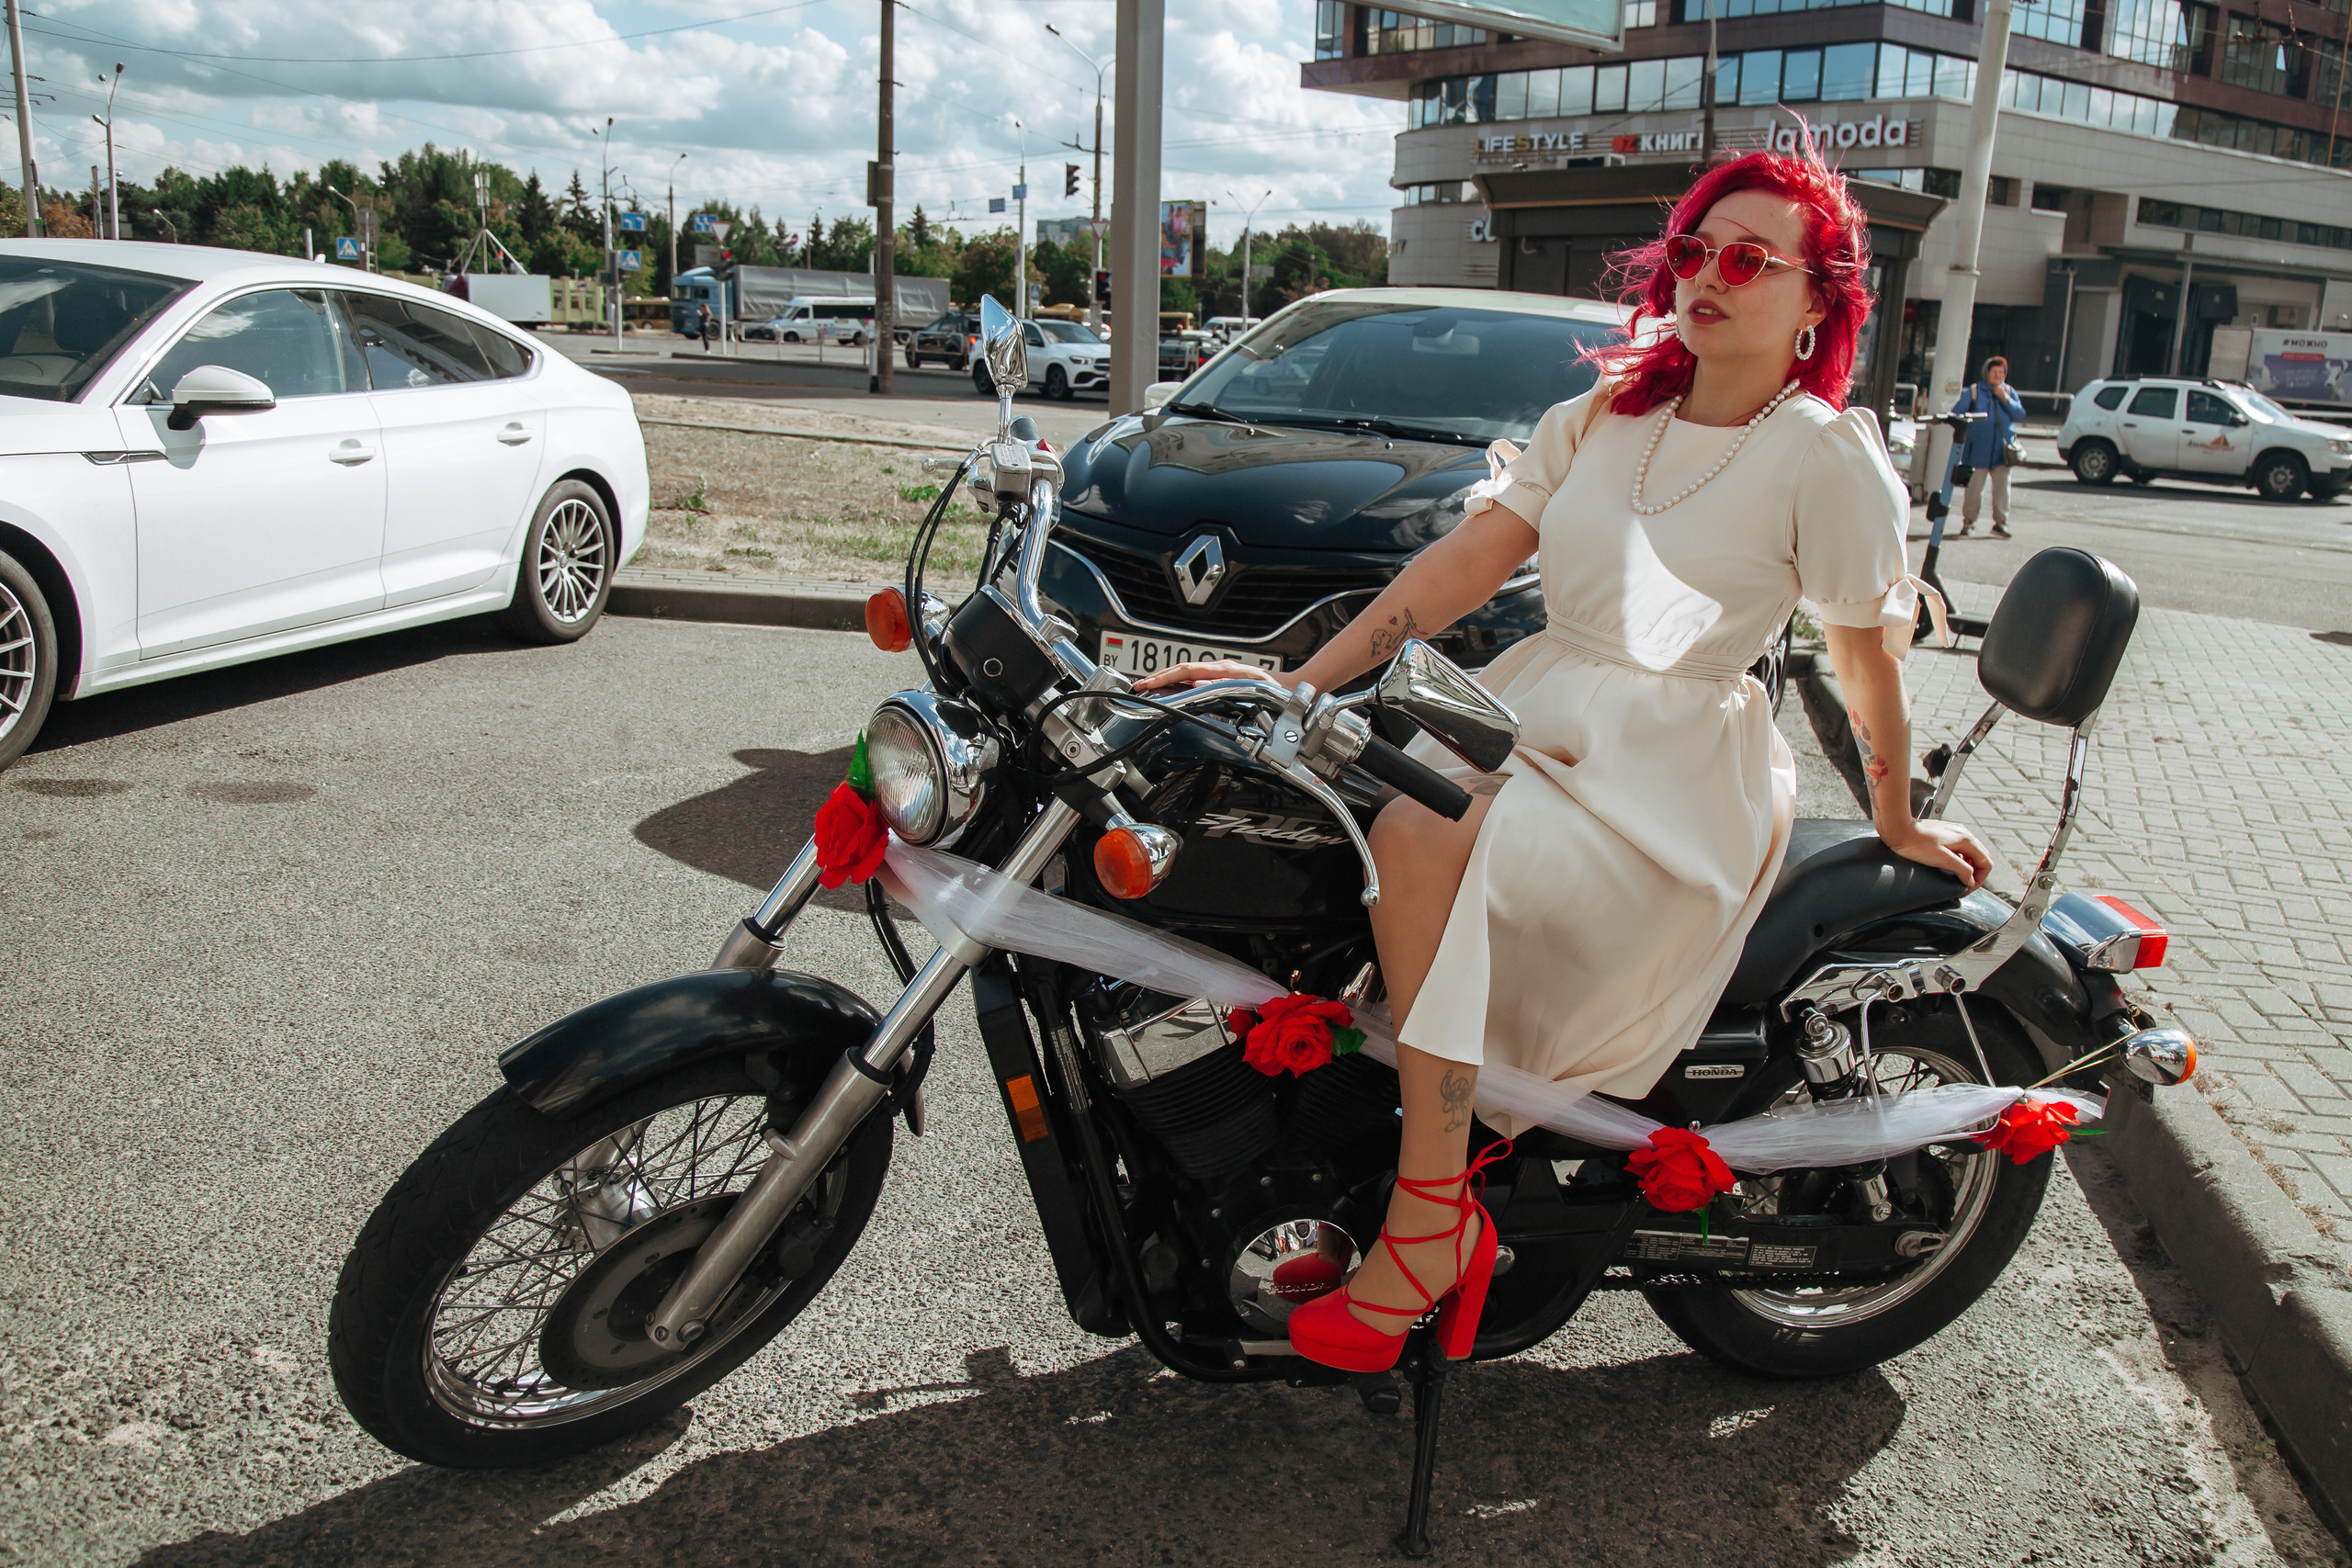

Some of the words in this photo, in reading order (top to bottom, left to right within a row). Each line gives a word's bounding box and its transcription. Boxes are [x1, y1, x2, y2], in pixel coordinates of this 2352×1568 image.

[1474, 131, 1584, 153] LIFESTYLE
[1766, 114, 1908, 152] lamoda
[1103, 654, 1118, 668] BY
[1195, 813, 1352, 844] Shadow
